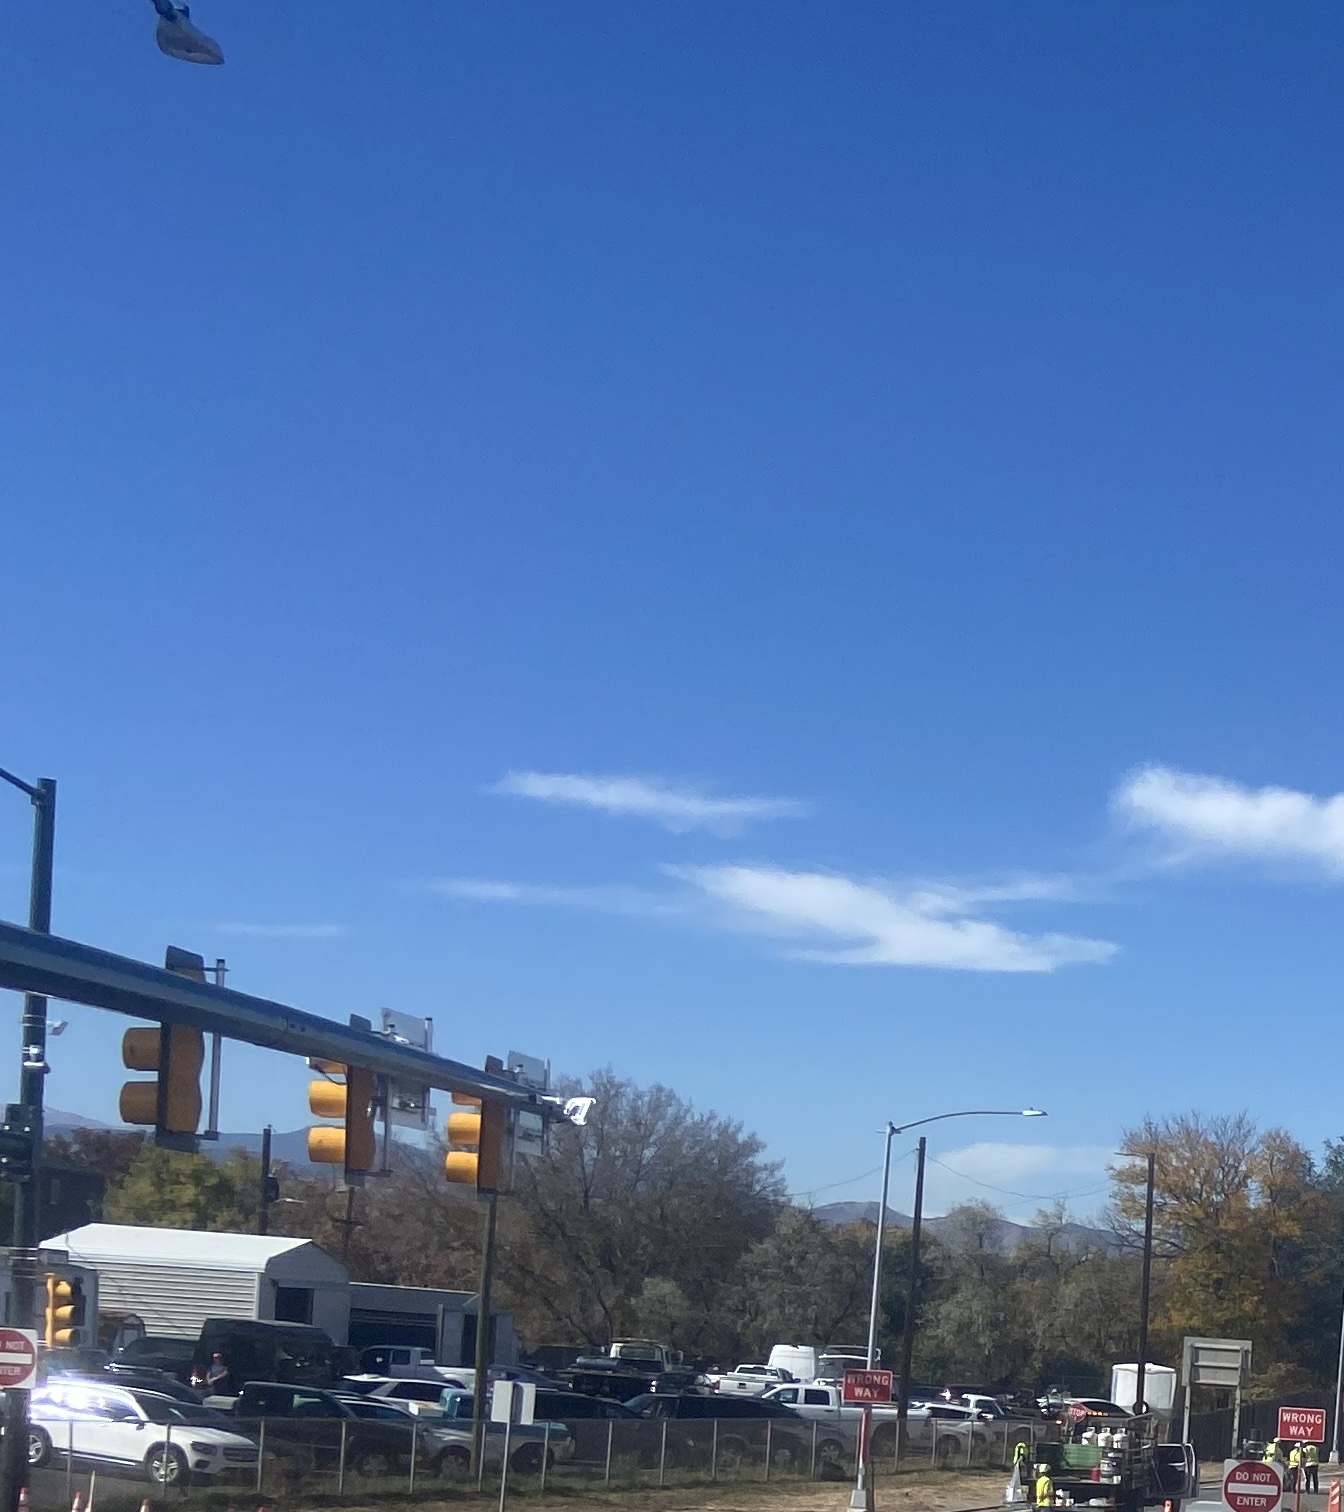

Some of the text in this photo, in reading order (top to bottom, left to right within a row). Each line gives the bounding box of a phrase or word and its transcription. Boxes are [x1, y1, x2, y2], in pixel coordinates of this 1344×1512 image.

[5, 1340, 25, 1350] NOT
[847, 1374, 889, 1385] WRONG
[854, 1387, 879, 1398] WAY
[1068, 1407, 1086, 1416] STOP
[1282, 1411, 1322, 1424] WRONG
[1290, 1426, 1314, 1436] WAY
[1235, 1471, 1271, 1482] DO NOT
[1237, 1496, 1266, 1506] ENTER
